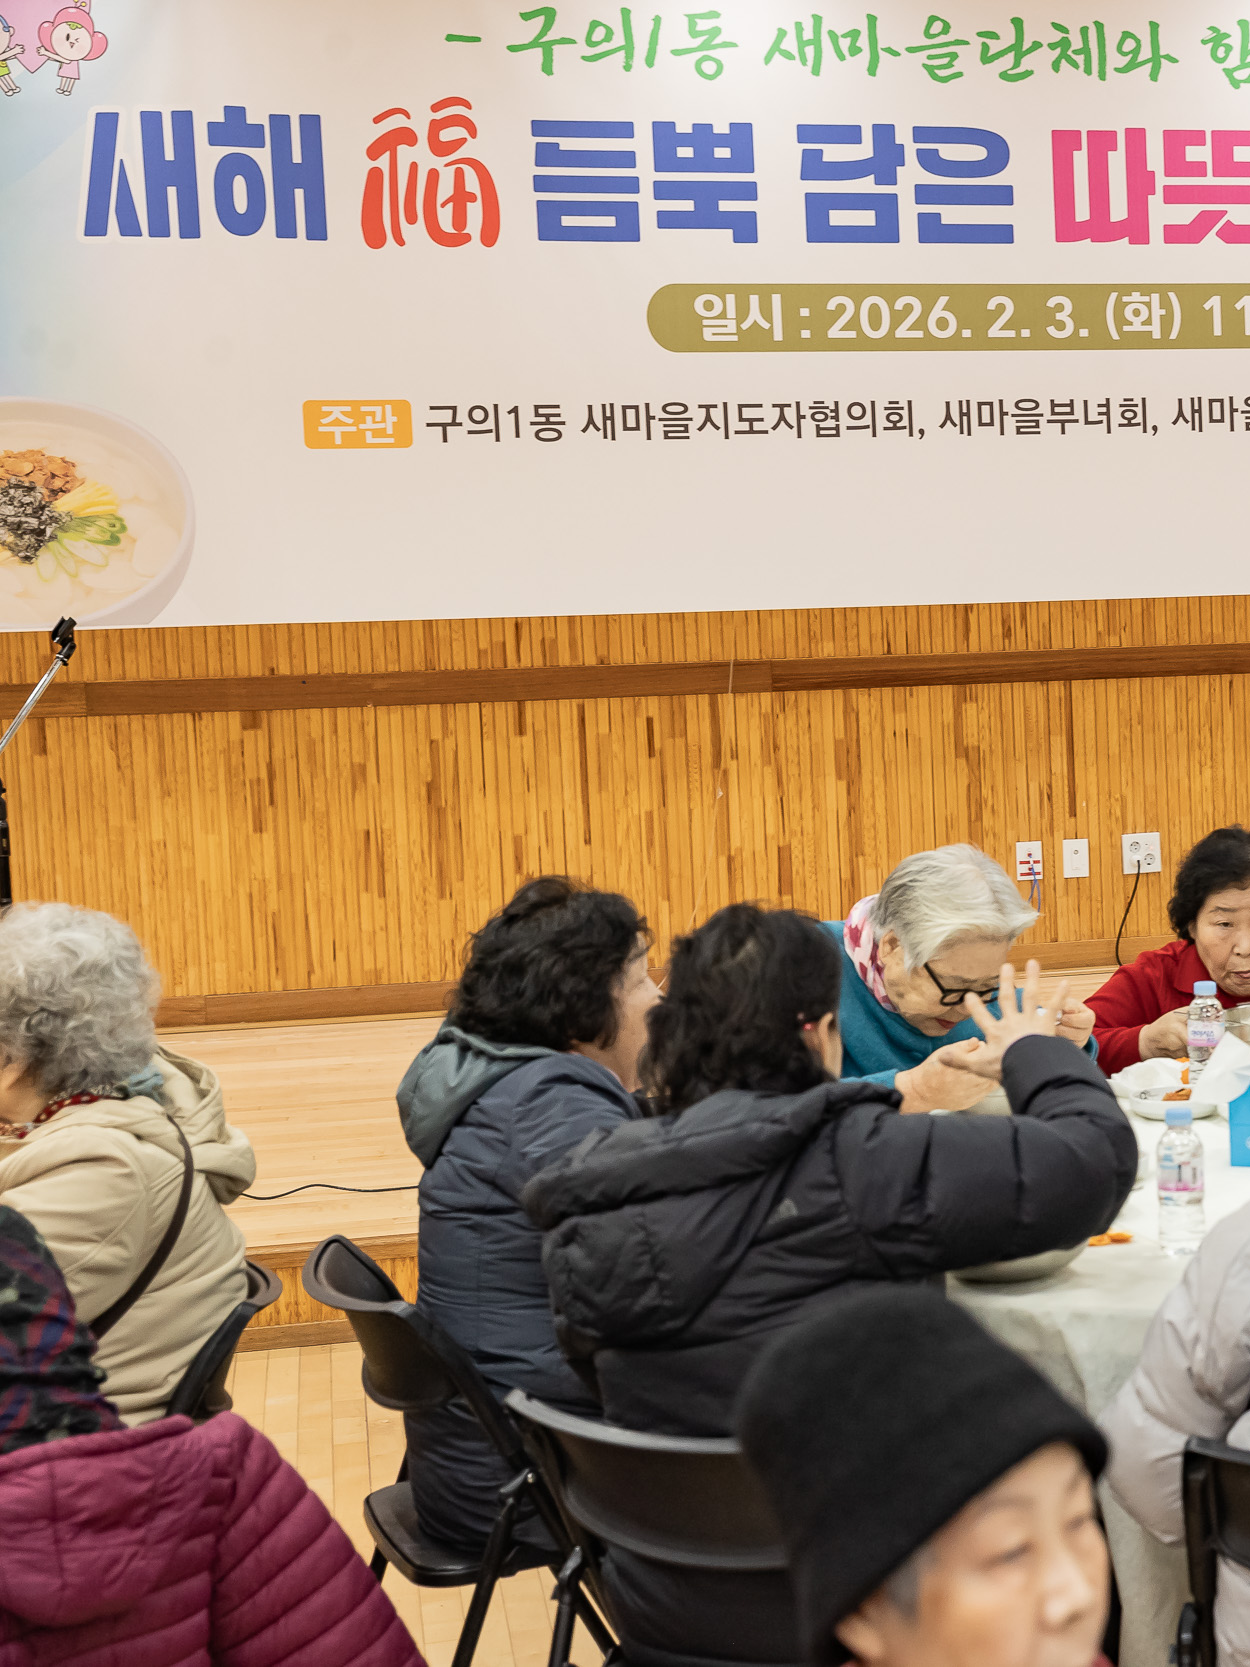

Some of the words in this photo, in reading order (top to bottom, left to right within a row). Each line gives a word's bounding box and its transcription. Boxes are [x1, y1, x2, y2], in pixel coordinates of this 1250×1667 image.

[506, 6, 738, 81] 구의1동
[764, 13, 1180, 84] 새마을단체와
[84, 105, 328, 241] 새해
[360, 96, 501, 250] 福
[531, 119, 759, 244] 듬뿍
[796, 123, 1014, 244] 담은
[693, 293, 784, 342] 일시
[826, 295, 972, 339] 2026.
[986, 295, 1031, 338] 2.
[1046, 295, 1089, 339] 3.
[1106, 291, 1182, 340] (화)
[318, 404, 398, 445] 주관
[425, 403, 566, 443] 구의1동
[580, 400, 926, 441] 새마을지도자협의회,
[938, 397, 1158, 437] 새마을부녀회,
